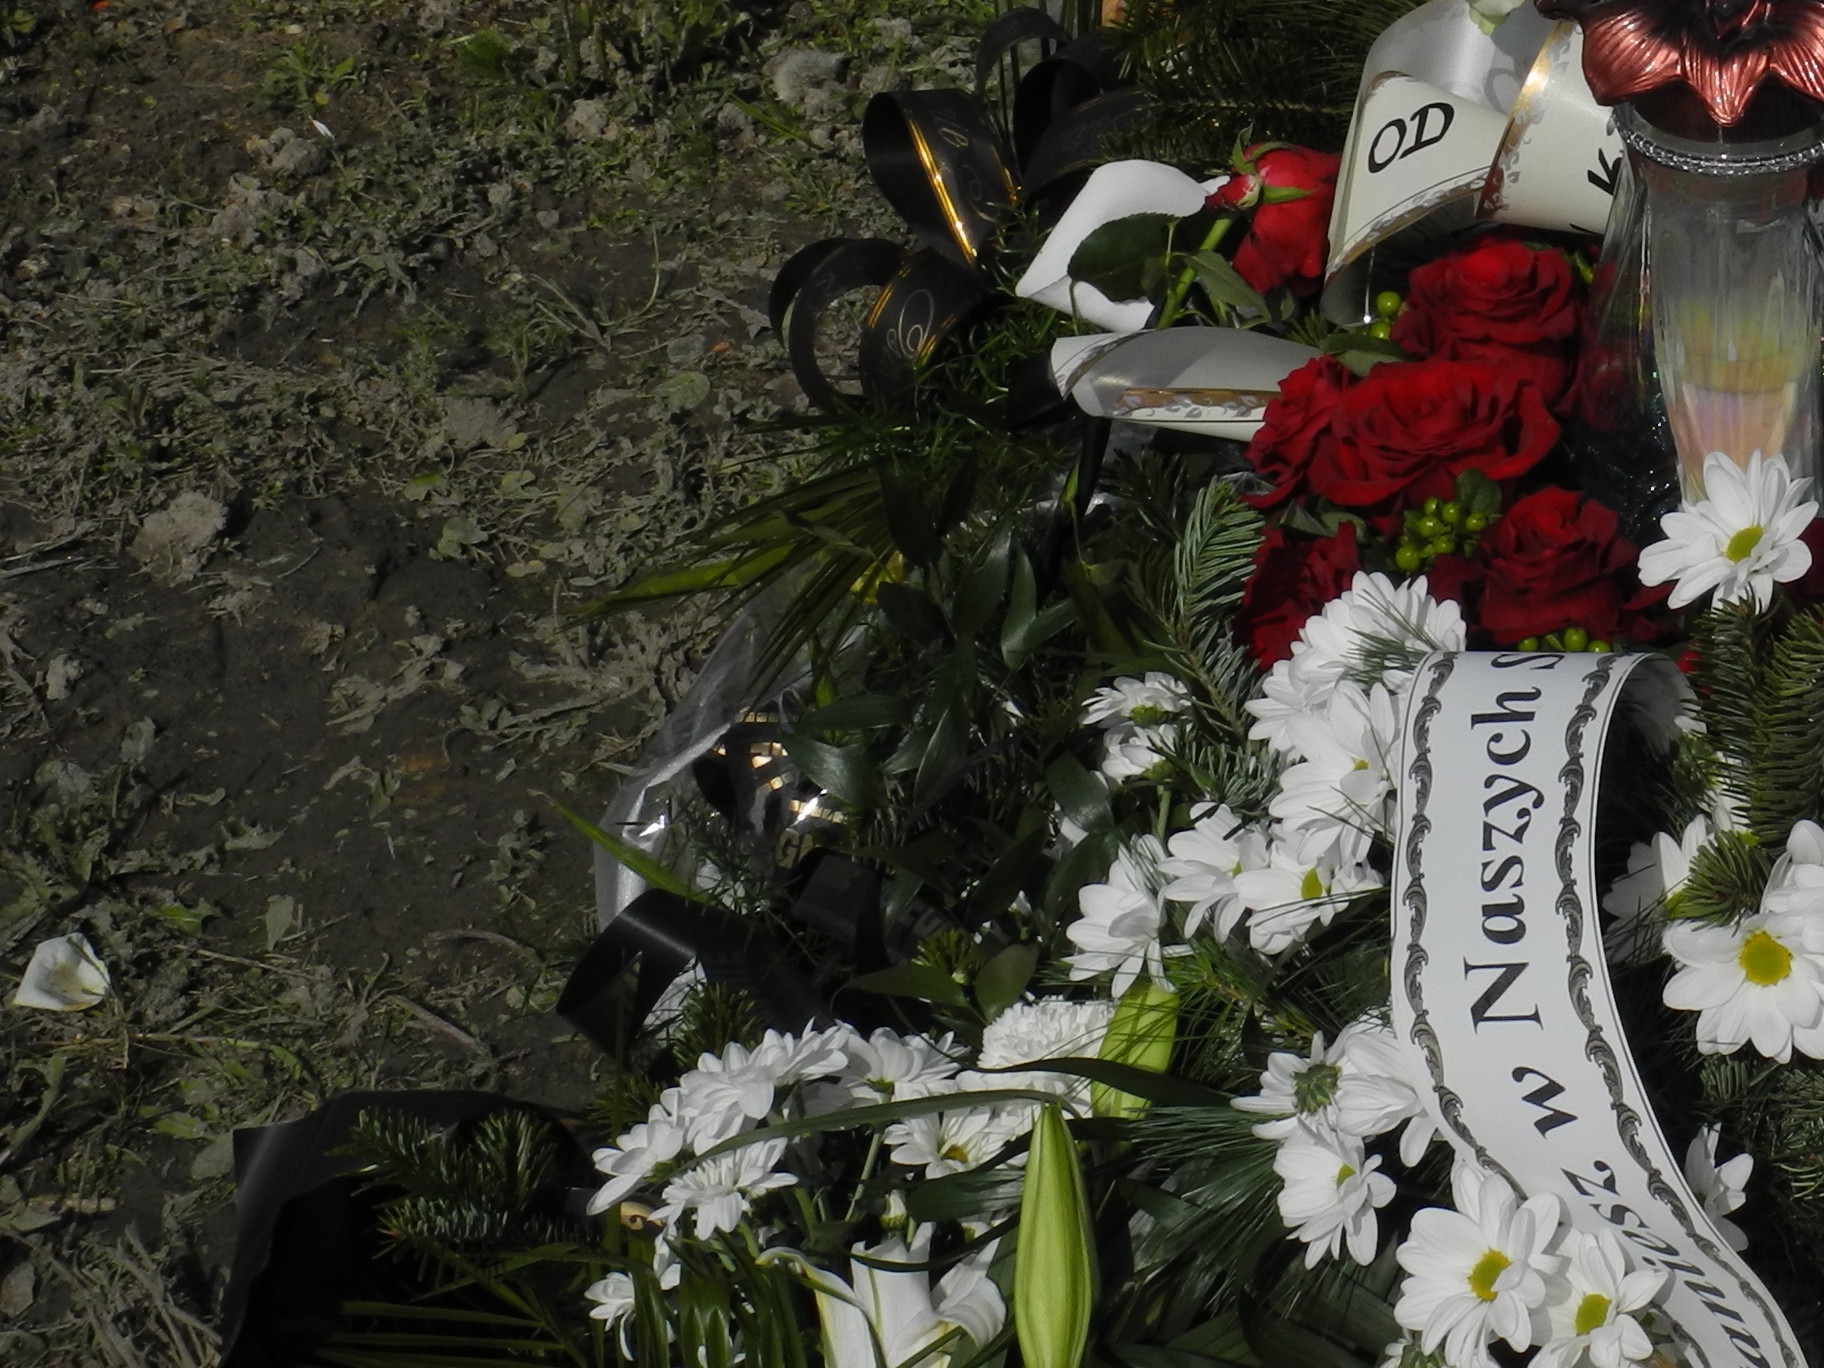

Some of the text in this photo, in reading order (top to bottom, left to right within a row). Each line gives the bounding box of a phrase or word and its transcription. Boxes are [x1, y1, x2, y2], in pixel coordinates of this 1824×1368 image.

[1368, 102, 1455, 174] OD
[1463, 685, 1545, 1034] Naszych
[1510, 1065, 1581, 1140] w
[1560, 1159, 1771, 1368] aniesz
